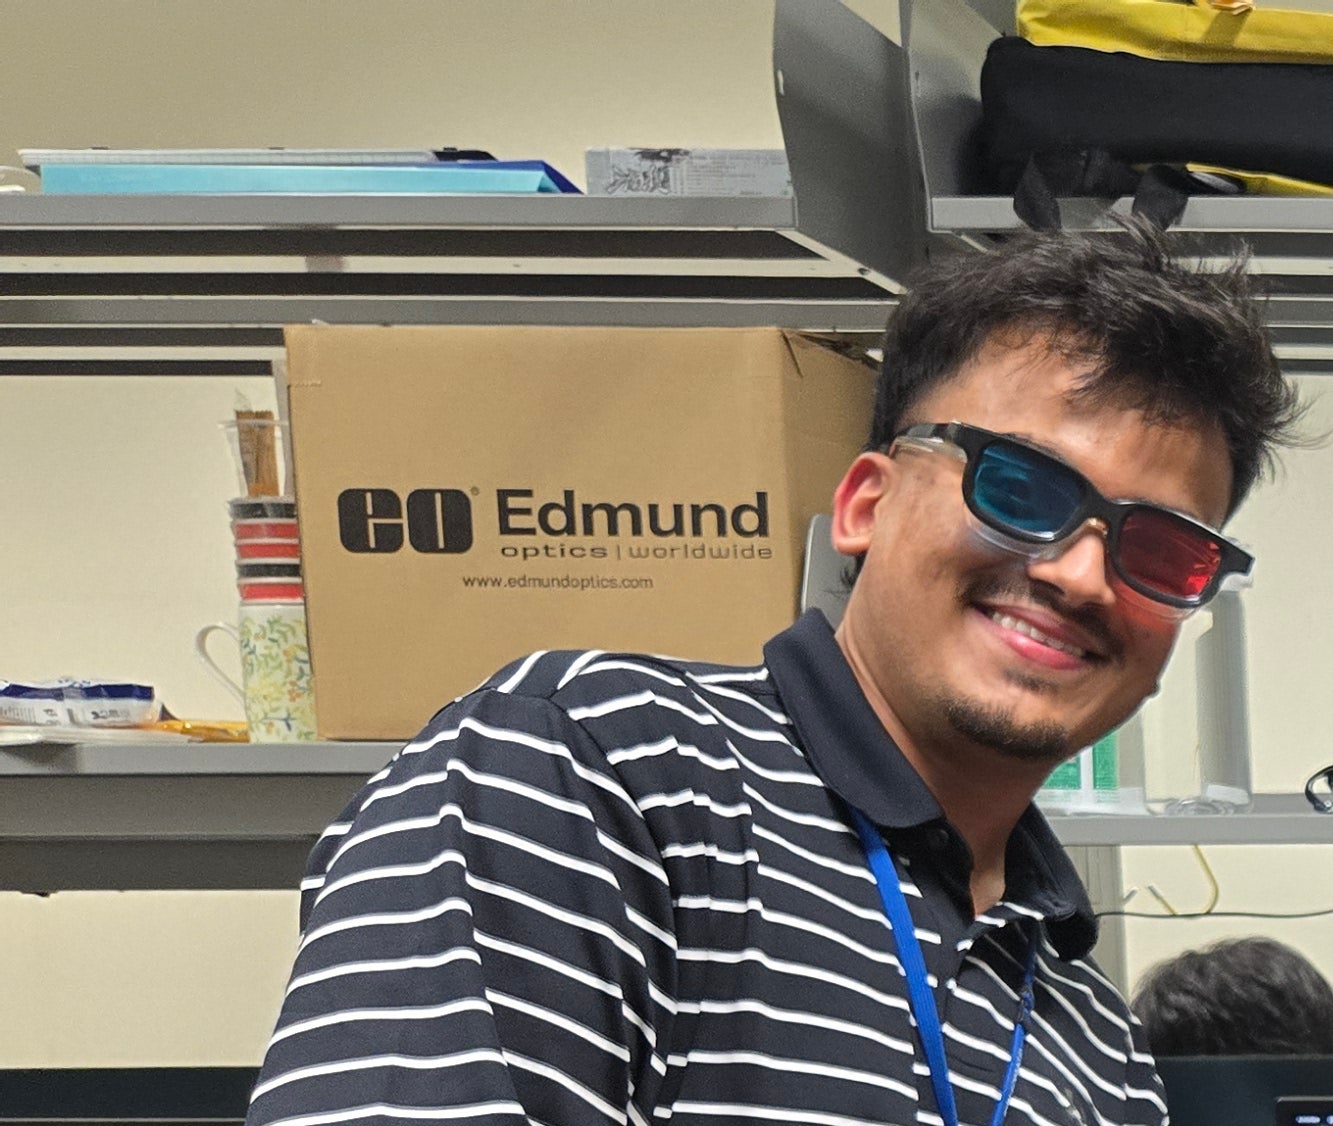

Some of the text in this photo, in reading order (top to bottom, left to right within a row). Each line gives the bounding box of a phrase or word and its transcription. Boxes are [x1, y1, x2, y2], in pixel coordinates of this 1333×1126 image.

[496, 489, 769, 538] Edmund
[501, 543, 773, 561] optics worldwide
[463, 574, 654, 591] www.edmundoptics.com
